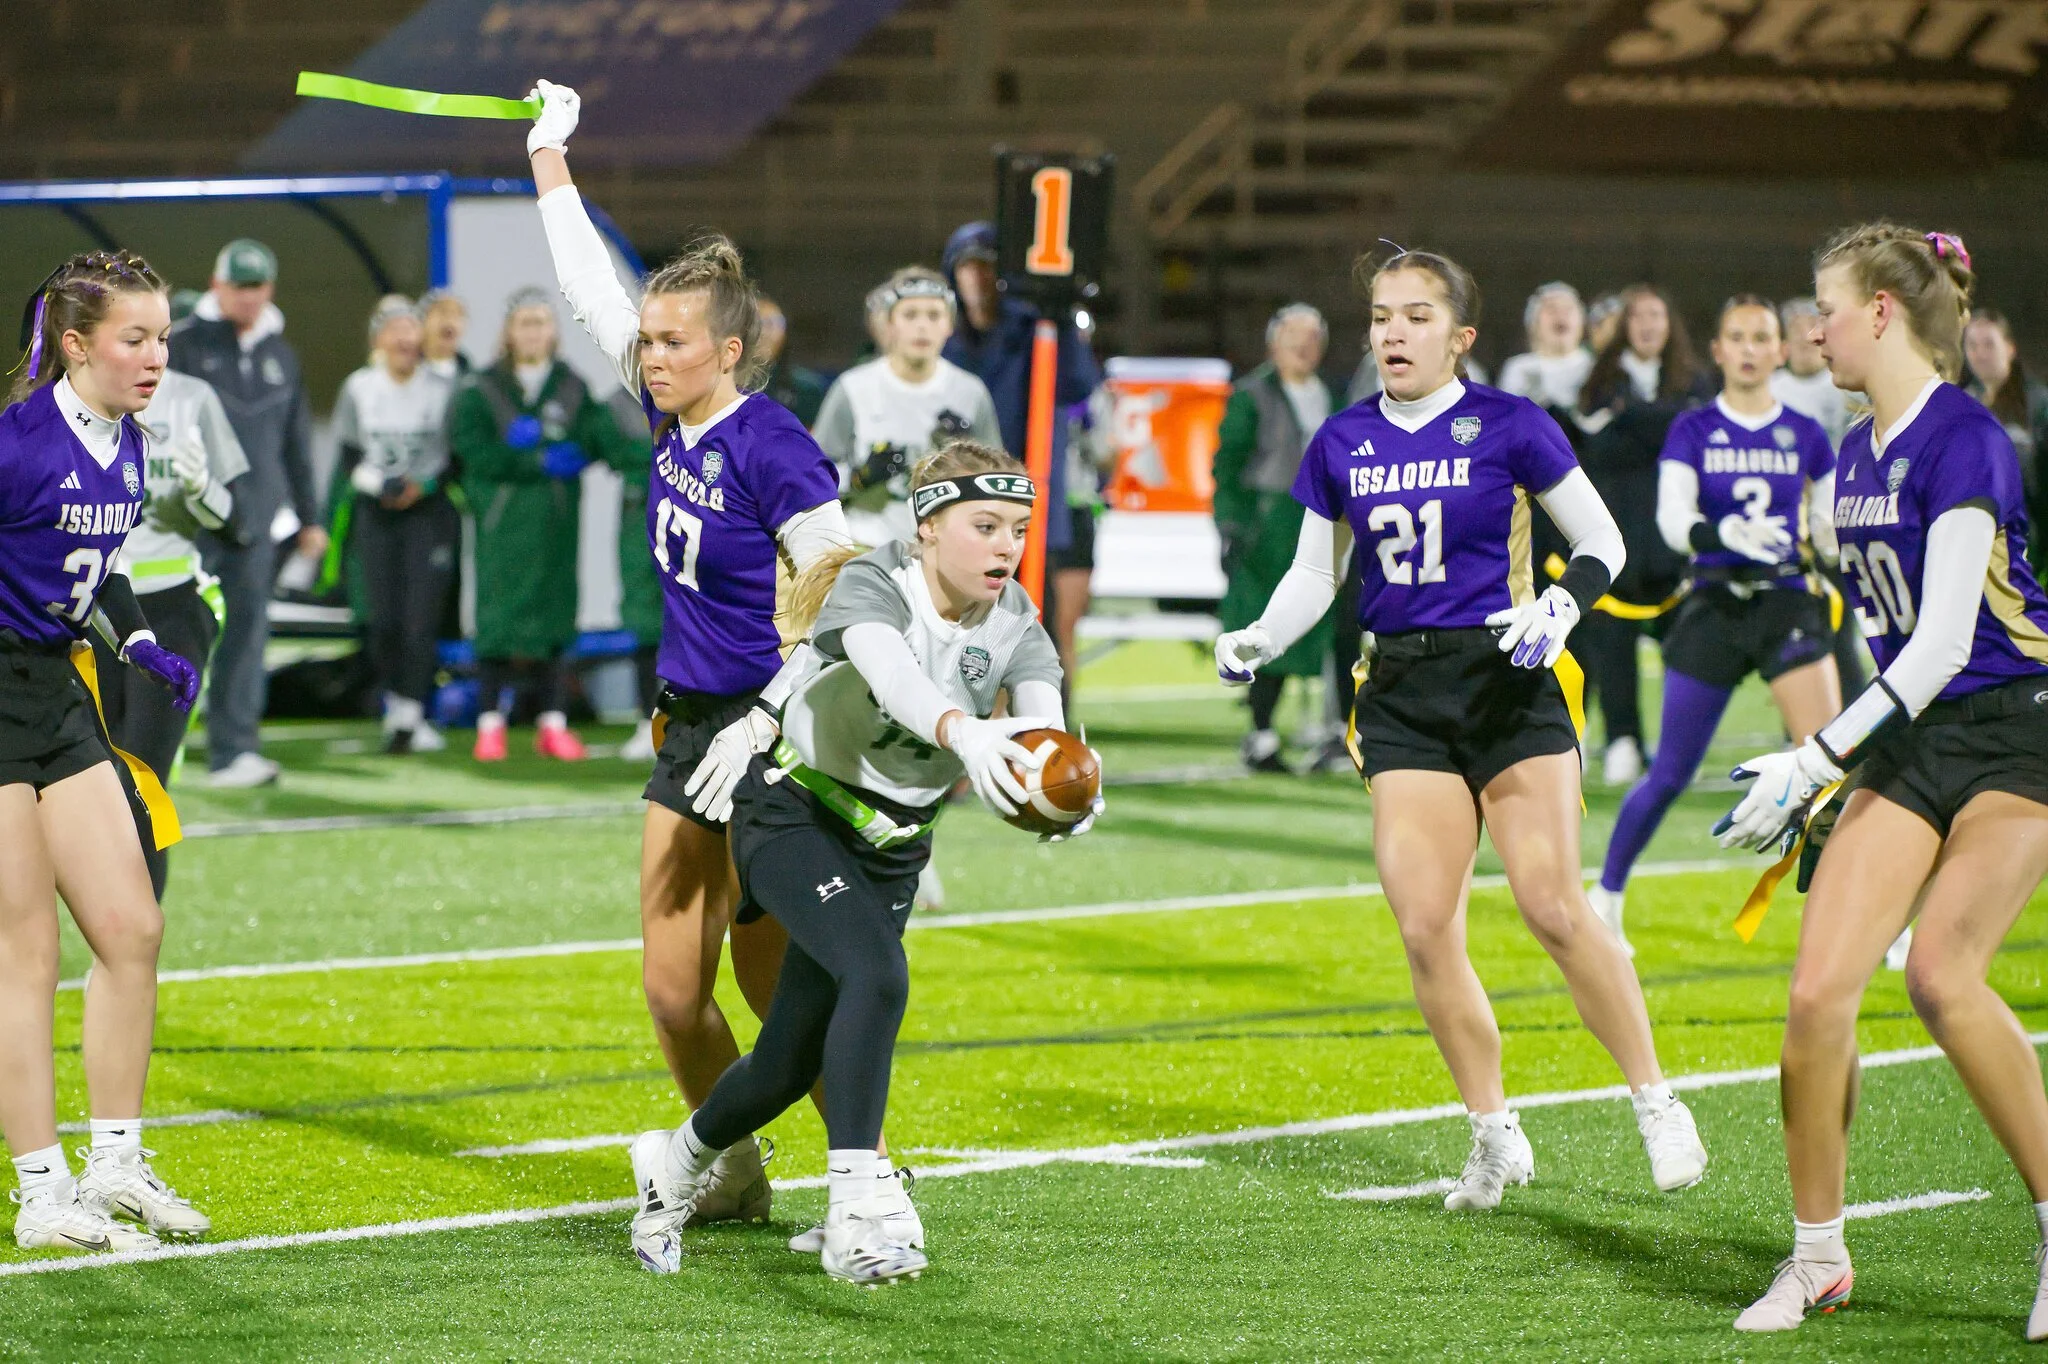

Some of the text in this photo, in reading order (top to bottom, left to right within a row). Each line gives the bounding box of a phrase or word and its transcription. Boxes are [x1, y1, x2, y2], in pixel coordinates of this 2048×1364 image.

[1026, 167, 1074, 276] 1
[1350, 457, 1471, 498] ISSAQUAH
[1704, 447, 1800, 475] ISSAQUAH
[654, 497, 702, 592] 17
[1367, 499, 1446, 585] 21
[1840, 541, 1917, 637] 30
